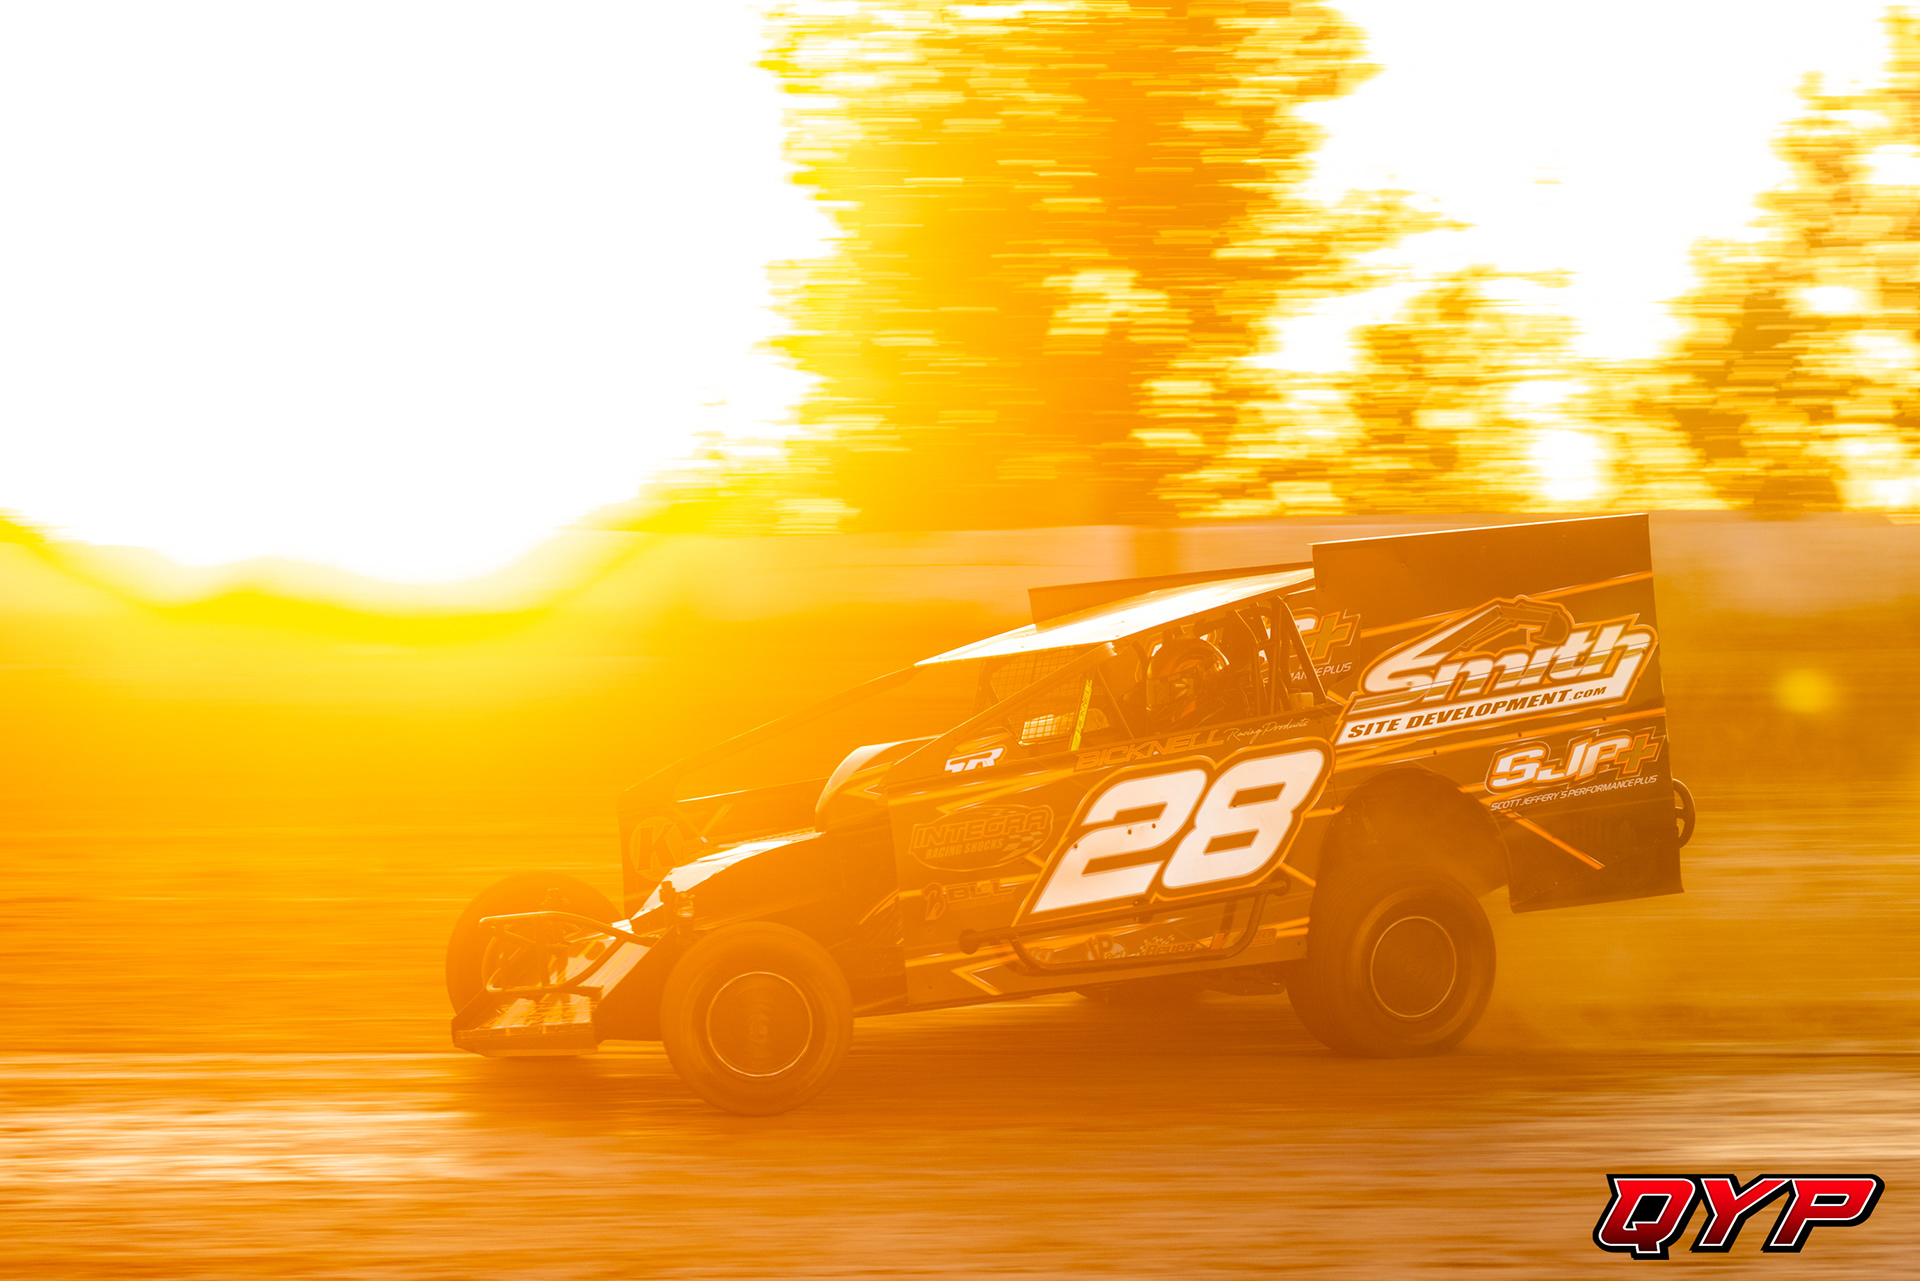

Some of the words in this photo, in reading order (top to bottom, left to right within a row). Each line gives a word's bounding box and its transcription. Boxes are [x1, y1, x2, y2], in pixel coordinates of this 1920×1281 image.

[1322, 661, 1353, 676] PLUS
[1350, 605, 1652, 708] Smith
[1075, 729, 1226, 772] BICKNELL
[1224, 727, 1262, 745] Racing
[1261, 717, 1311, 737] Products
[1347, 718, 1399, 739] SITE
[1490, 798, 1521, 812] SCOTT
[1567, 778, 1635, 798] PERFORMANCE
[1633, 774, 1658, 787] PLUS
[914, 810, 1049, 849] INTEGRA
[1030, 749, 1325, 915] 28
[925, 844, 963, 860] RACING
[964, 838, 1004, 854] SHOCKS
